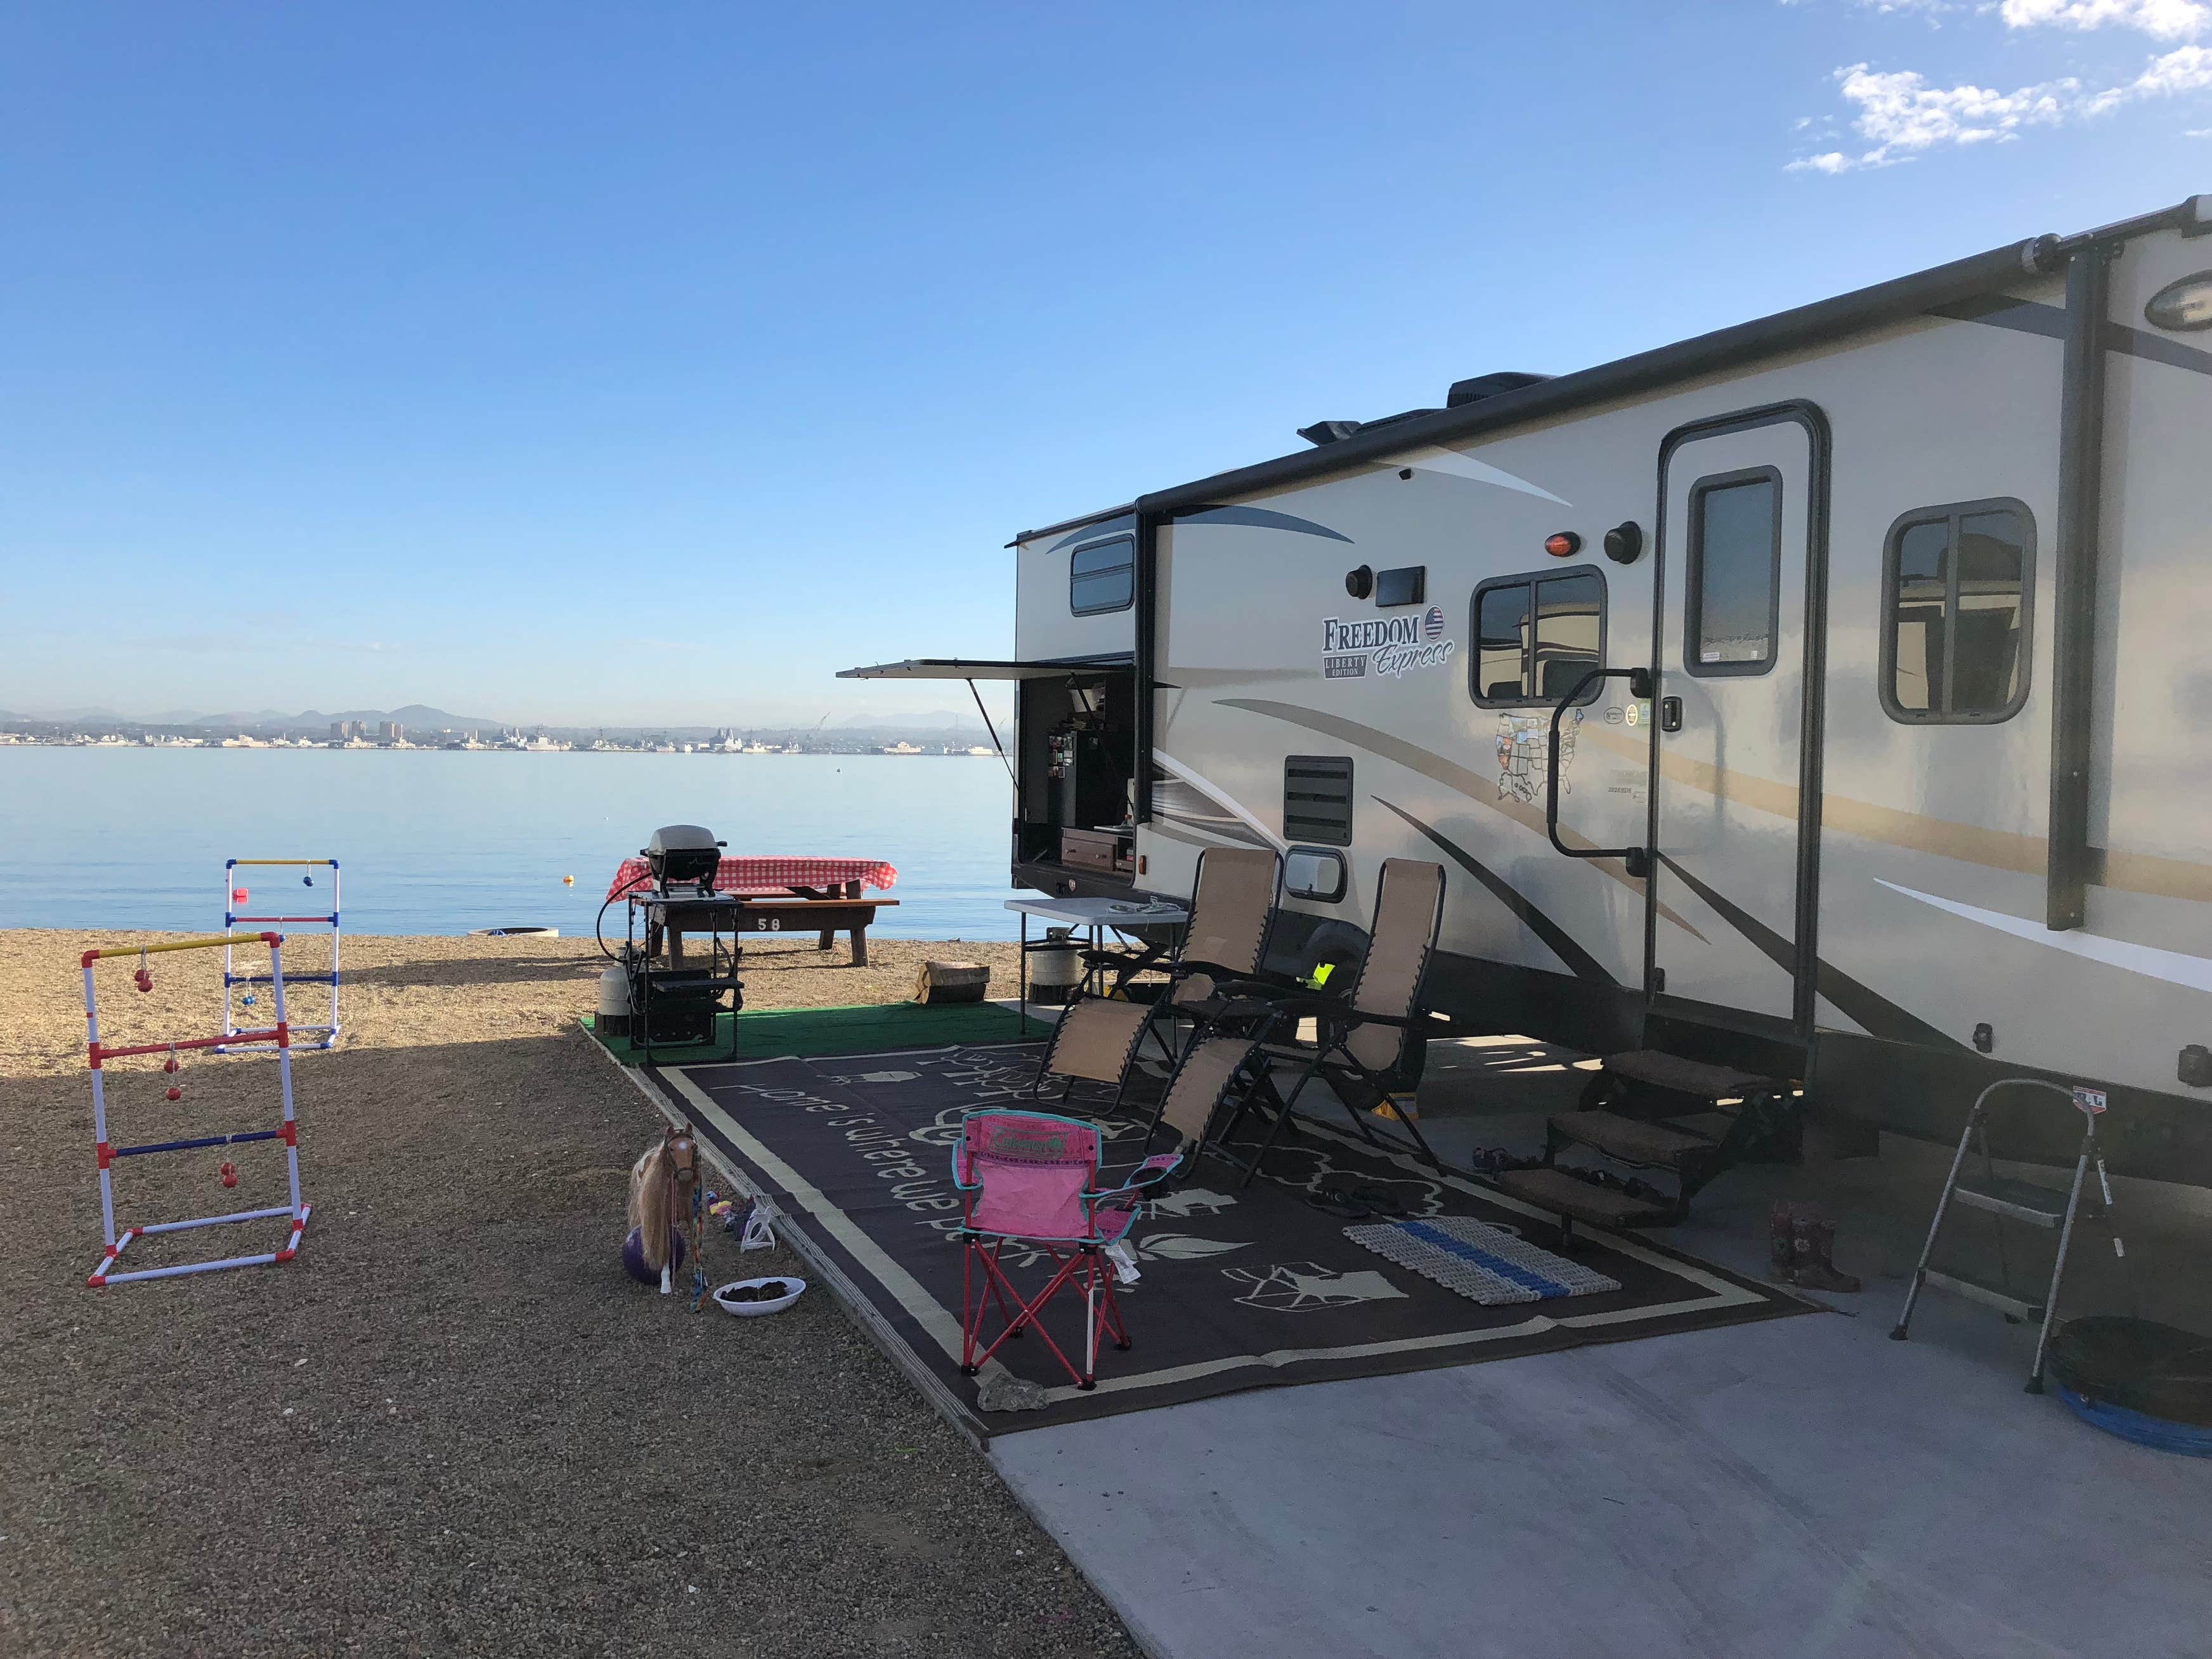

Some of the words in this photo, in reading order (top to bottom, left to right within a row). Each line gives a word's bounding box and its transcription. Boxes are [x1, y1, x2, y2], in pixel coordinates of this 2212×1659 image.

[1323, 617, 1419, 651] FREEDOM
[1325, 656, 1366, 668] LIBERTY
[1332, 668, 1358, 677] EDITION
[1372, 642, 1454, 677] Express
[758, 918, 781, 931] 58
[710, 1083, 850, 1112] Home
[826, 1112, 876, 1126] is
[845, 1126, 927, 1178] where
[890, 1180, 960, 1211] we
